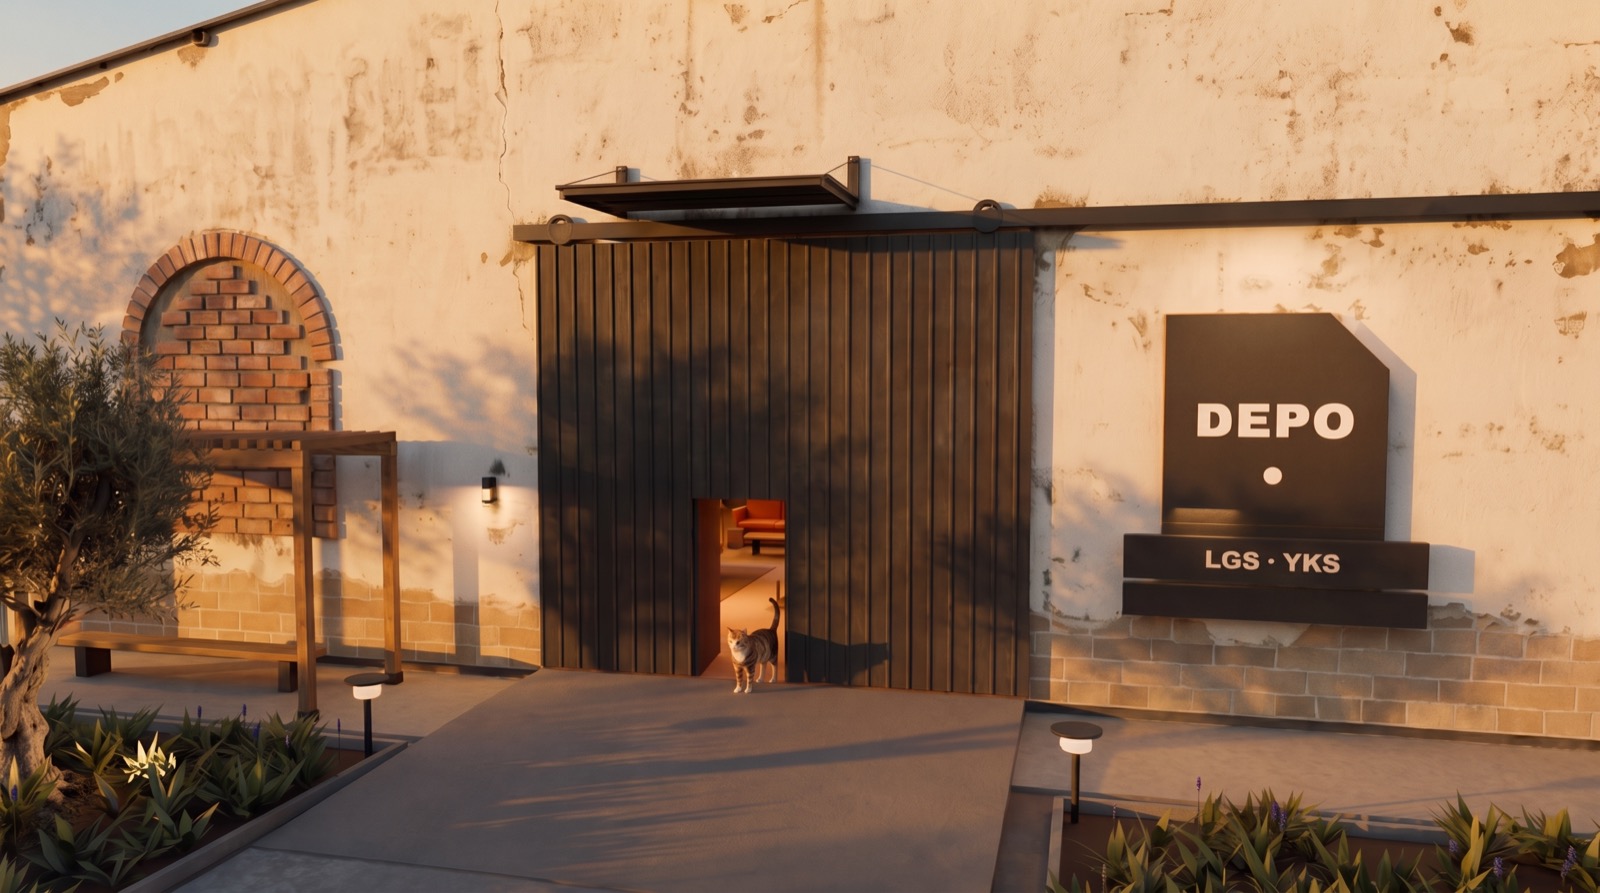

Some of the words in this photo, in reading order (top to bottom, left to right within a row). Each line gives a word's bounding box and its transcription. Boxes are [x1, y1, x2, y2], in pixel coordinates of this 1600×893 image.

[1196, 402, 1355, 440] DEPO
[1205, 549, 1260, 571] LGS
[1282, 552, 1341, 574] YKS
